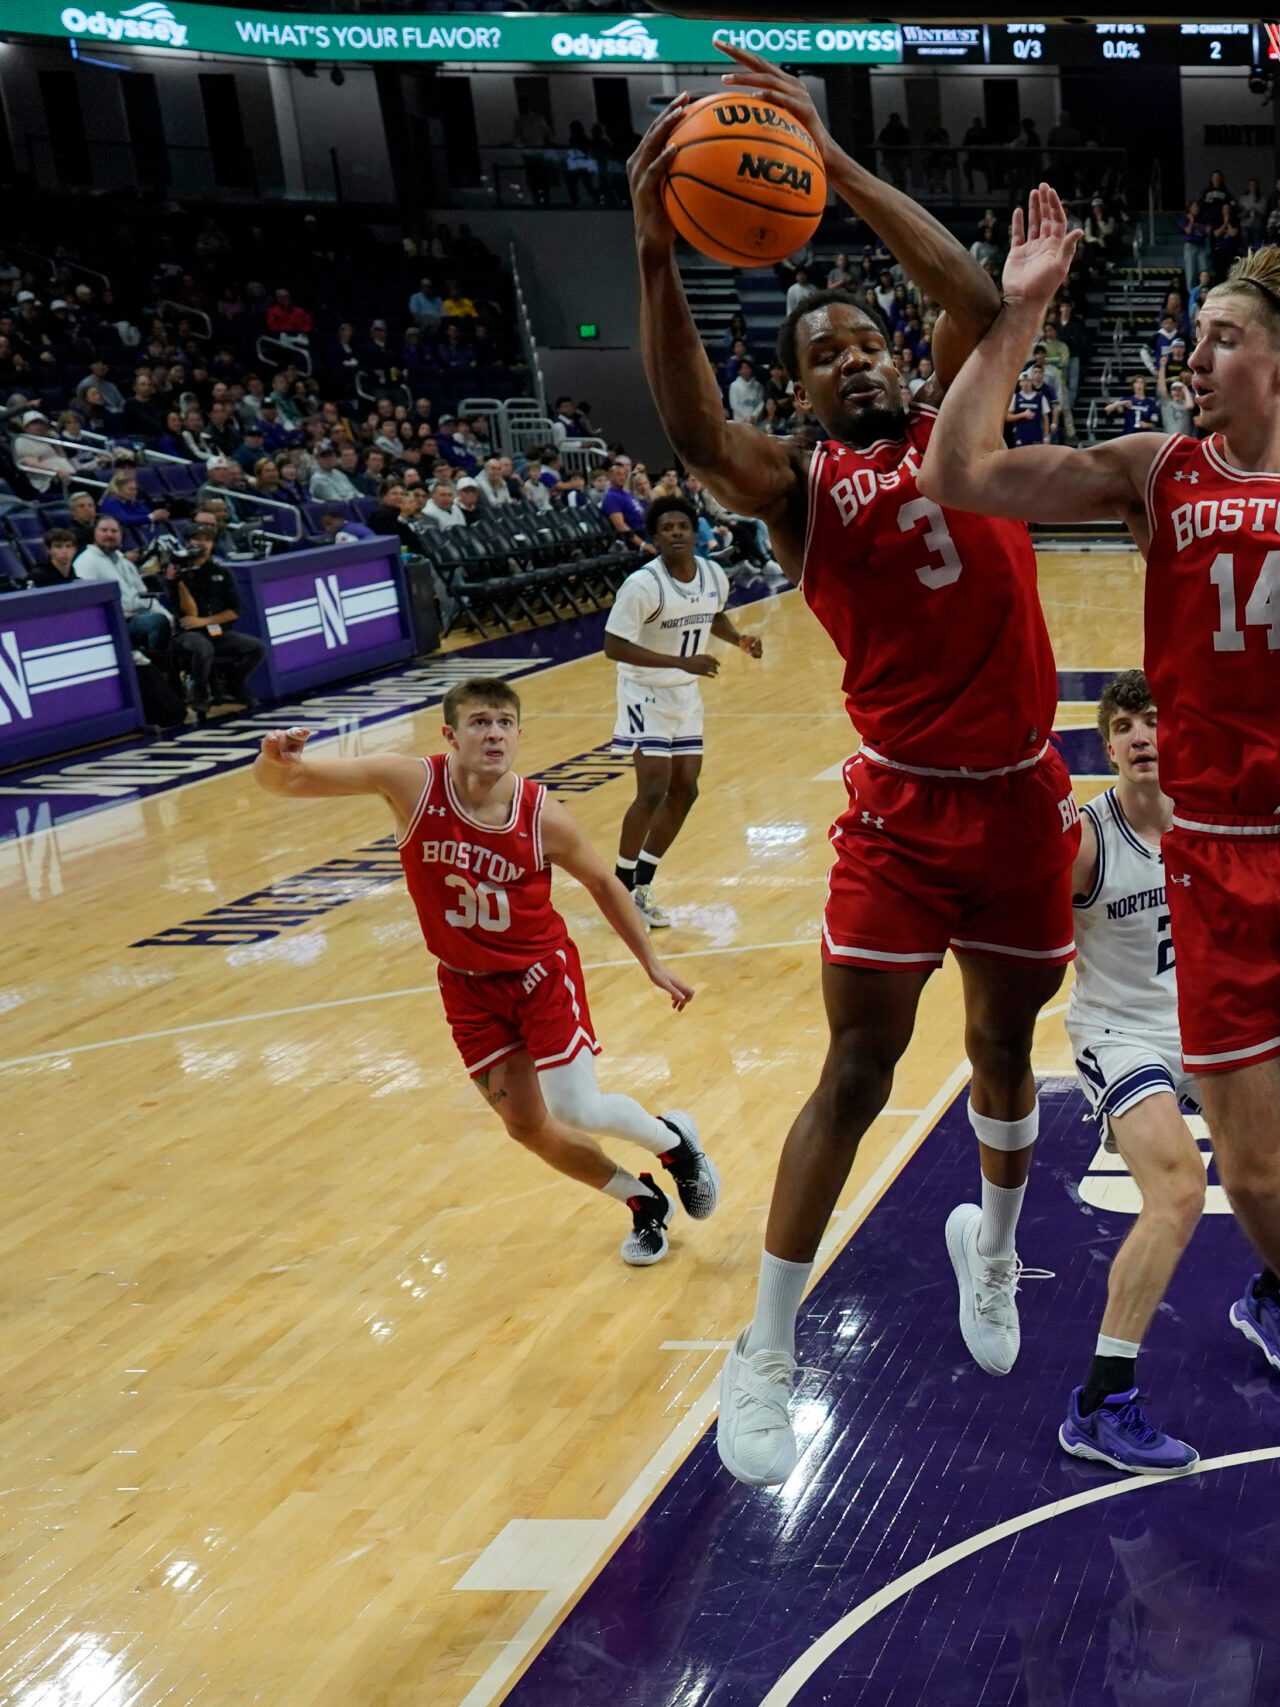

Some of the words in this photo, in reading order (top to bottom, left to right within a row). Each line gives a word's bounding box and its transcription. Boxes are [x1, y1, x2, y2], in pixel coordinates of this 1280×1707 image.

[61, 8, 188, 46] Odyssey
[235, 20, 331, 48] WHAT'S
[332, 26, 398, 48] YOUR
[402, 27, 501, 49] FLAVOR?
[713, 29, 812, 51] CHOOSE
[551, 32, 658, 60] Odyssey
[1013, 39, 1042, 59] 0/3
[1102, 40, 1140, 59] 0.0%
[1210, 41, 1222, 59] 2
[737, 152, 813, 195] NCAA
[830, 446, 921, 527] BOST
[897, 496, 963, 590] 3
[315, 574, 349, 649] N
[680, 629, 702, 657] 11
[627, 704, 645, 734] N
[422, 840, 525, 882] BOSTON
[444, 873, 511, 932] 30
